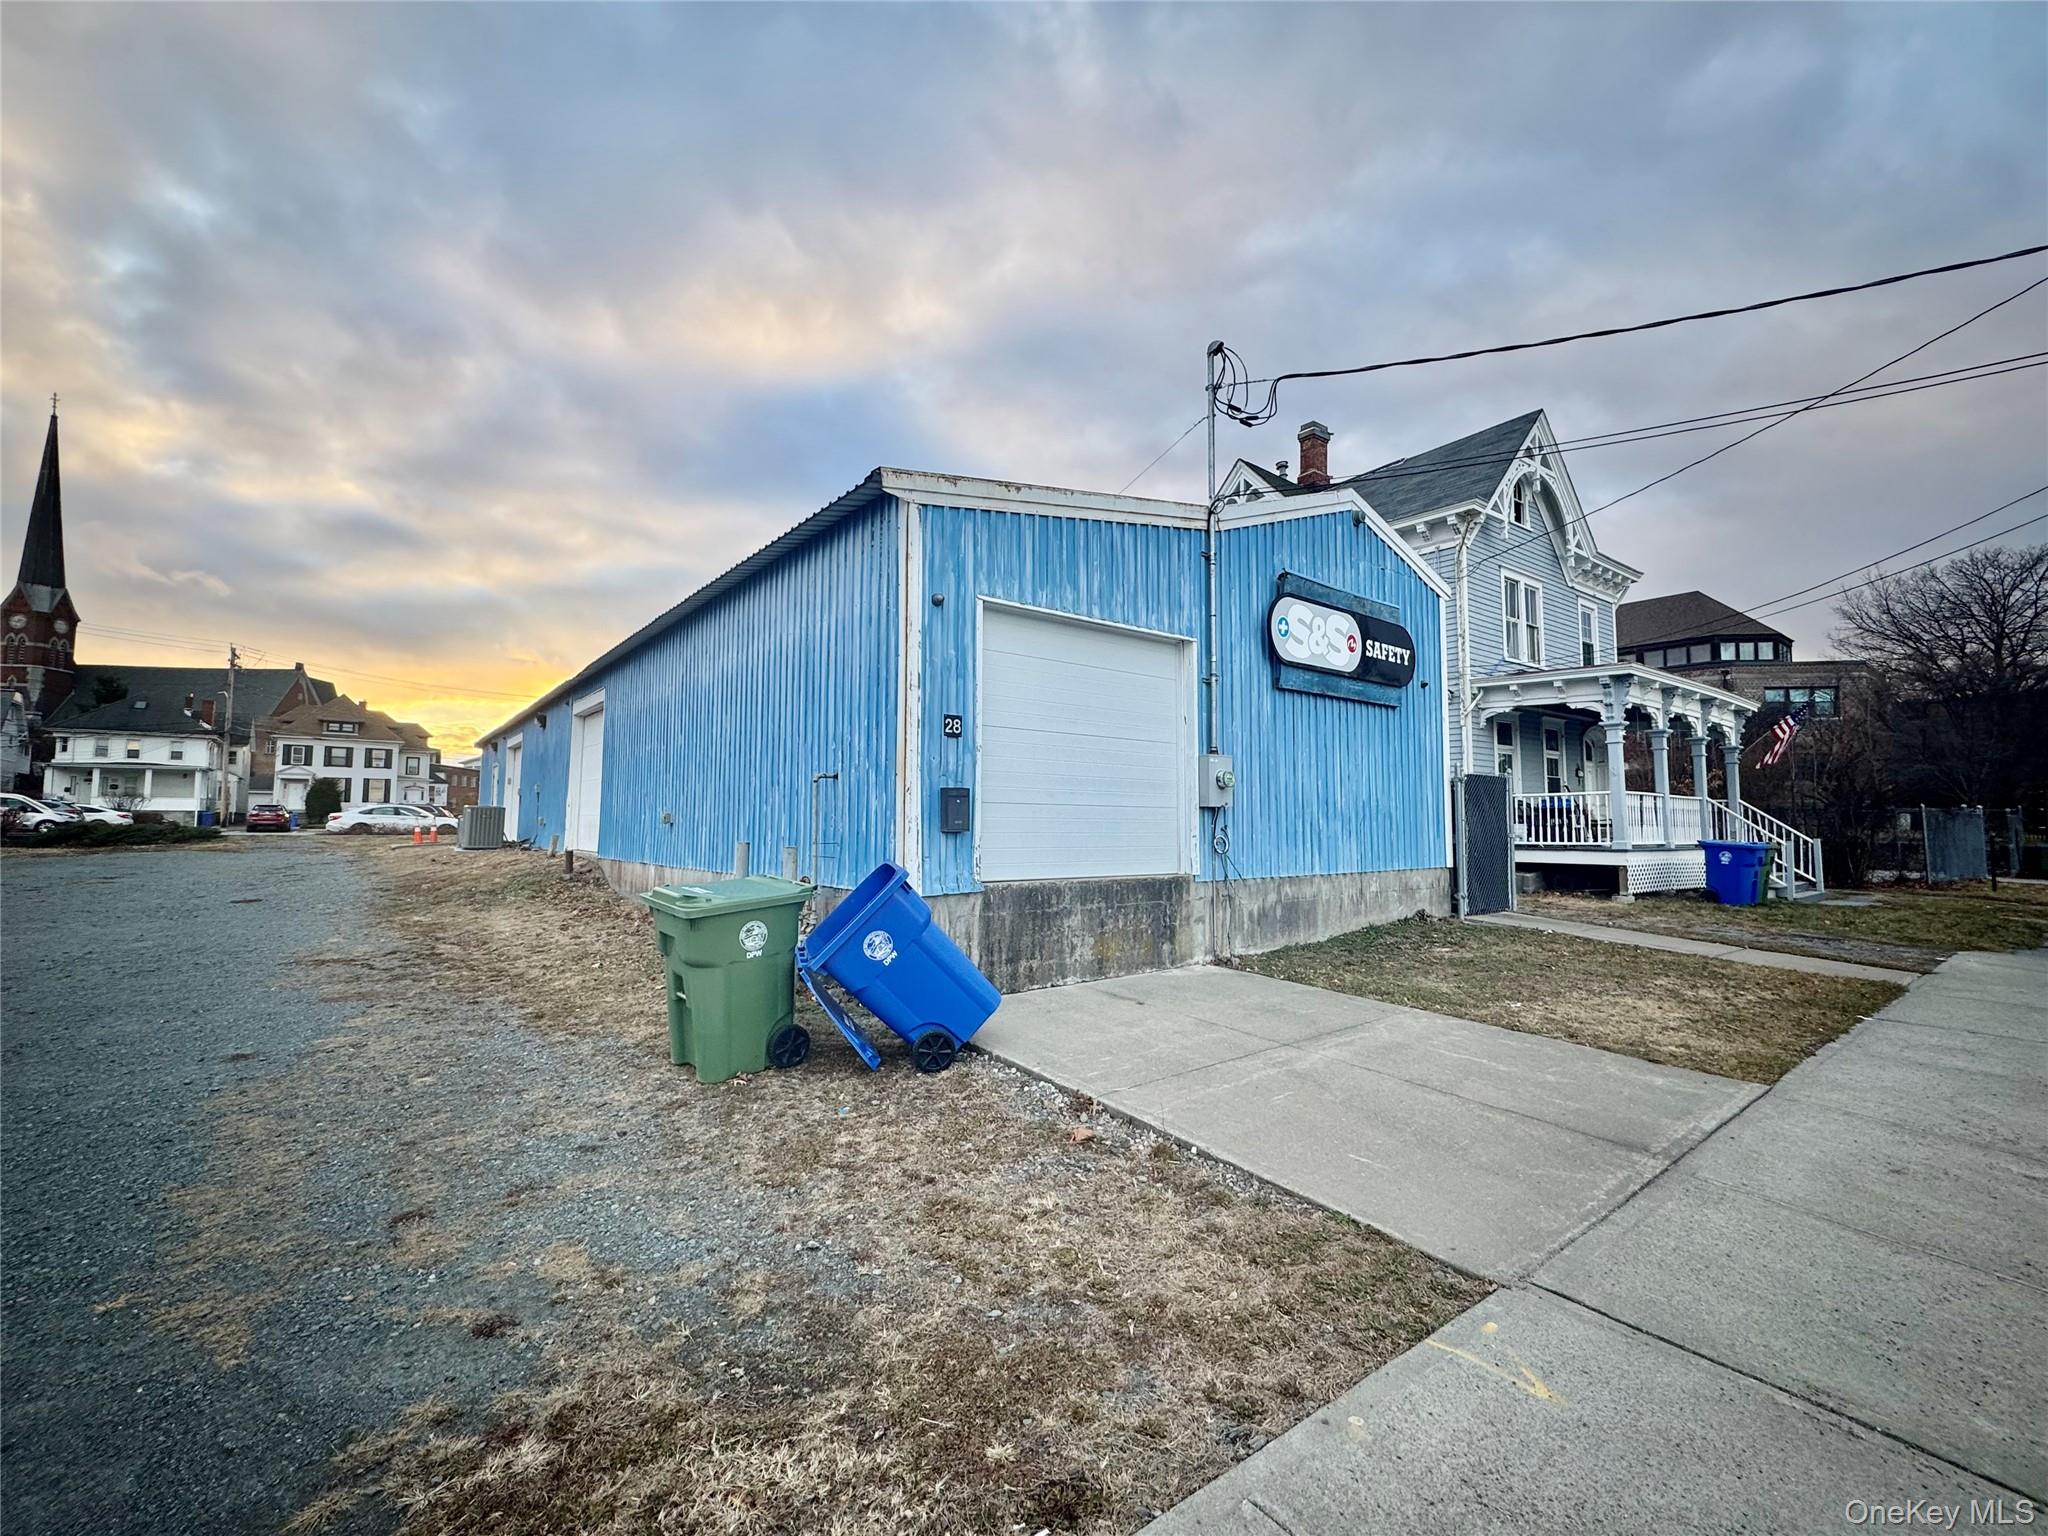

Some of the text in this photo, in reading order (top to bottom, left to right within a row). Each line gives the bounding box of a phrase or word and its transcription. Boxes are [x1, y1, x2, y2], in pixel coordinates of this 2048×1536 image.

[1285, 604, 1411, 667] S&S SAFETY
[944, 718, 962, 734] 28
[746, 949, 763, 960] DPW
[882, 950, 898, 966] DPW
